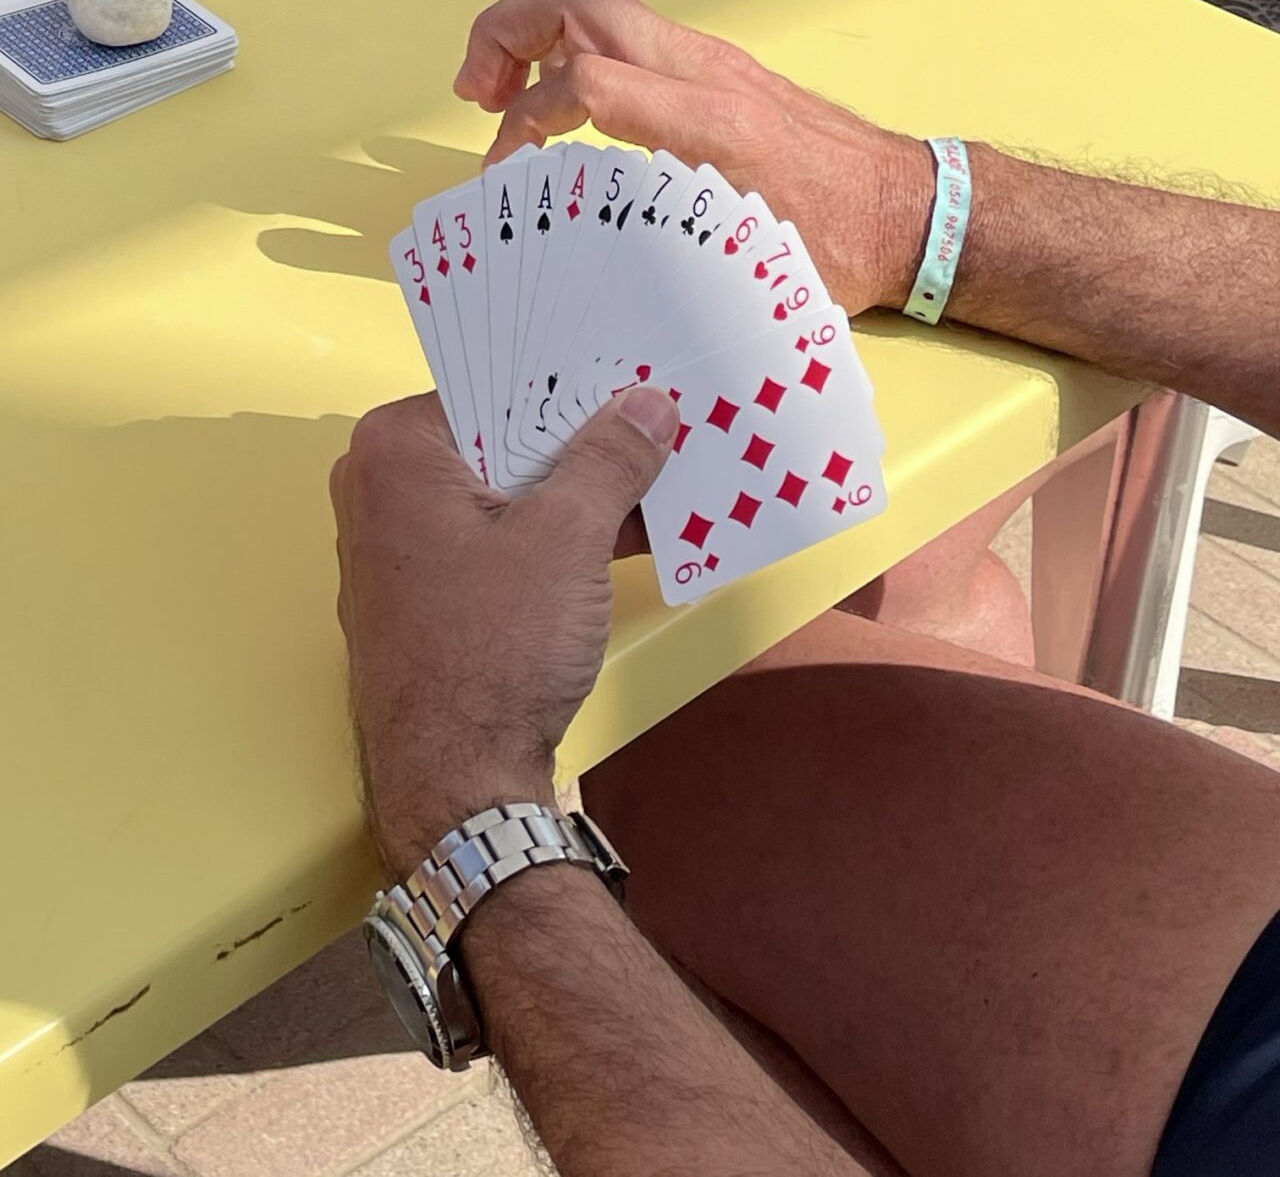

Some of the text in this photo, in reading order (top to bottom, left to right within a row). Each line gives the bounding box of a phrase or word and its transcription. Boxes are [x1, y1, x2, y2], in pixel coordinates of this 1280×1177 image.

[537, 174, 553, 210] A
[570, 163, 586, 199] A
[605, 167, 625, 202] 5
[652, 171, 673, 203] 7
[498, 183, 514, 220] A
[693, 188, 715, 218] 6
[431, 217, 448, 252] 4
[454, 213, 473, 250] 3
[736, 216, 759, 243] 6
[403, 247, 426, 284] 3
[766, 241, 792, 264] 7
[786, 286, 810, 311] 9
[811, 324, 836, 346] 9
[848, 485, 873, 507] 9
